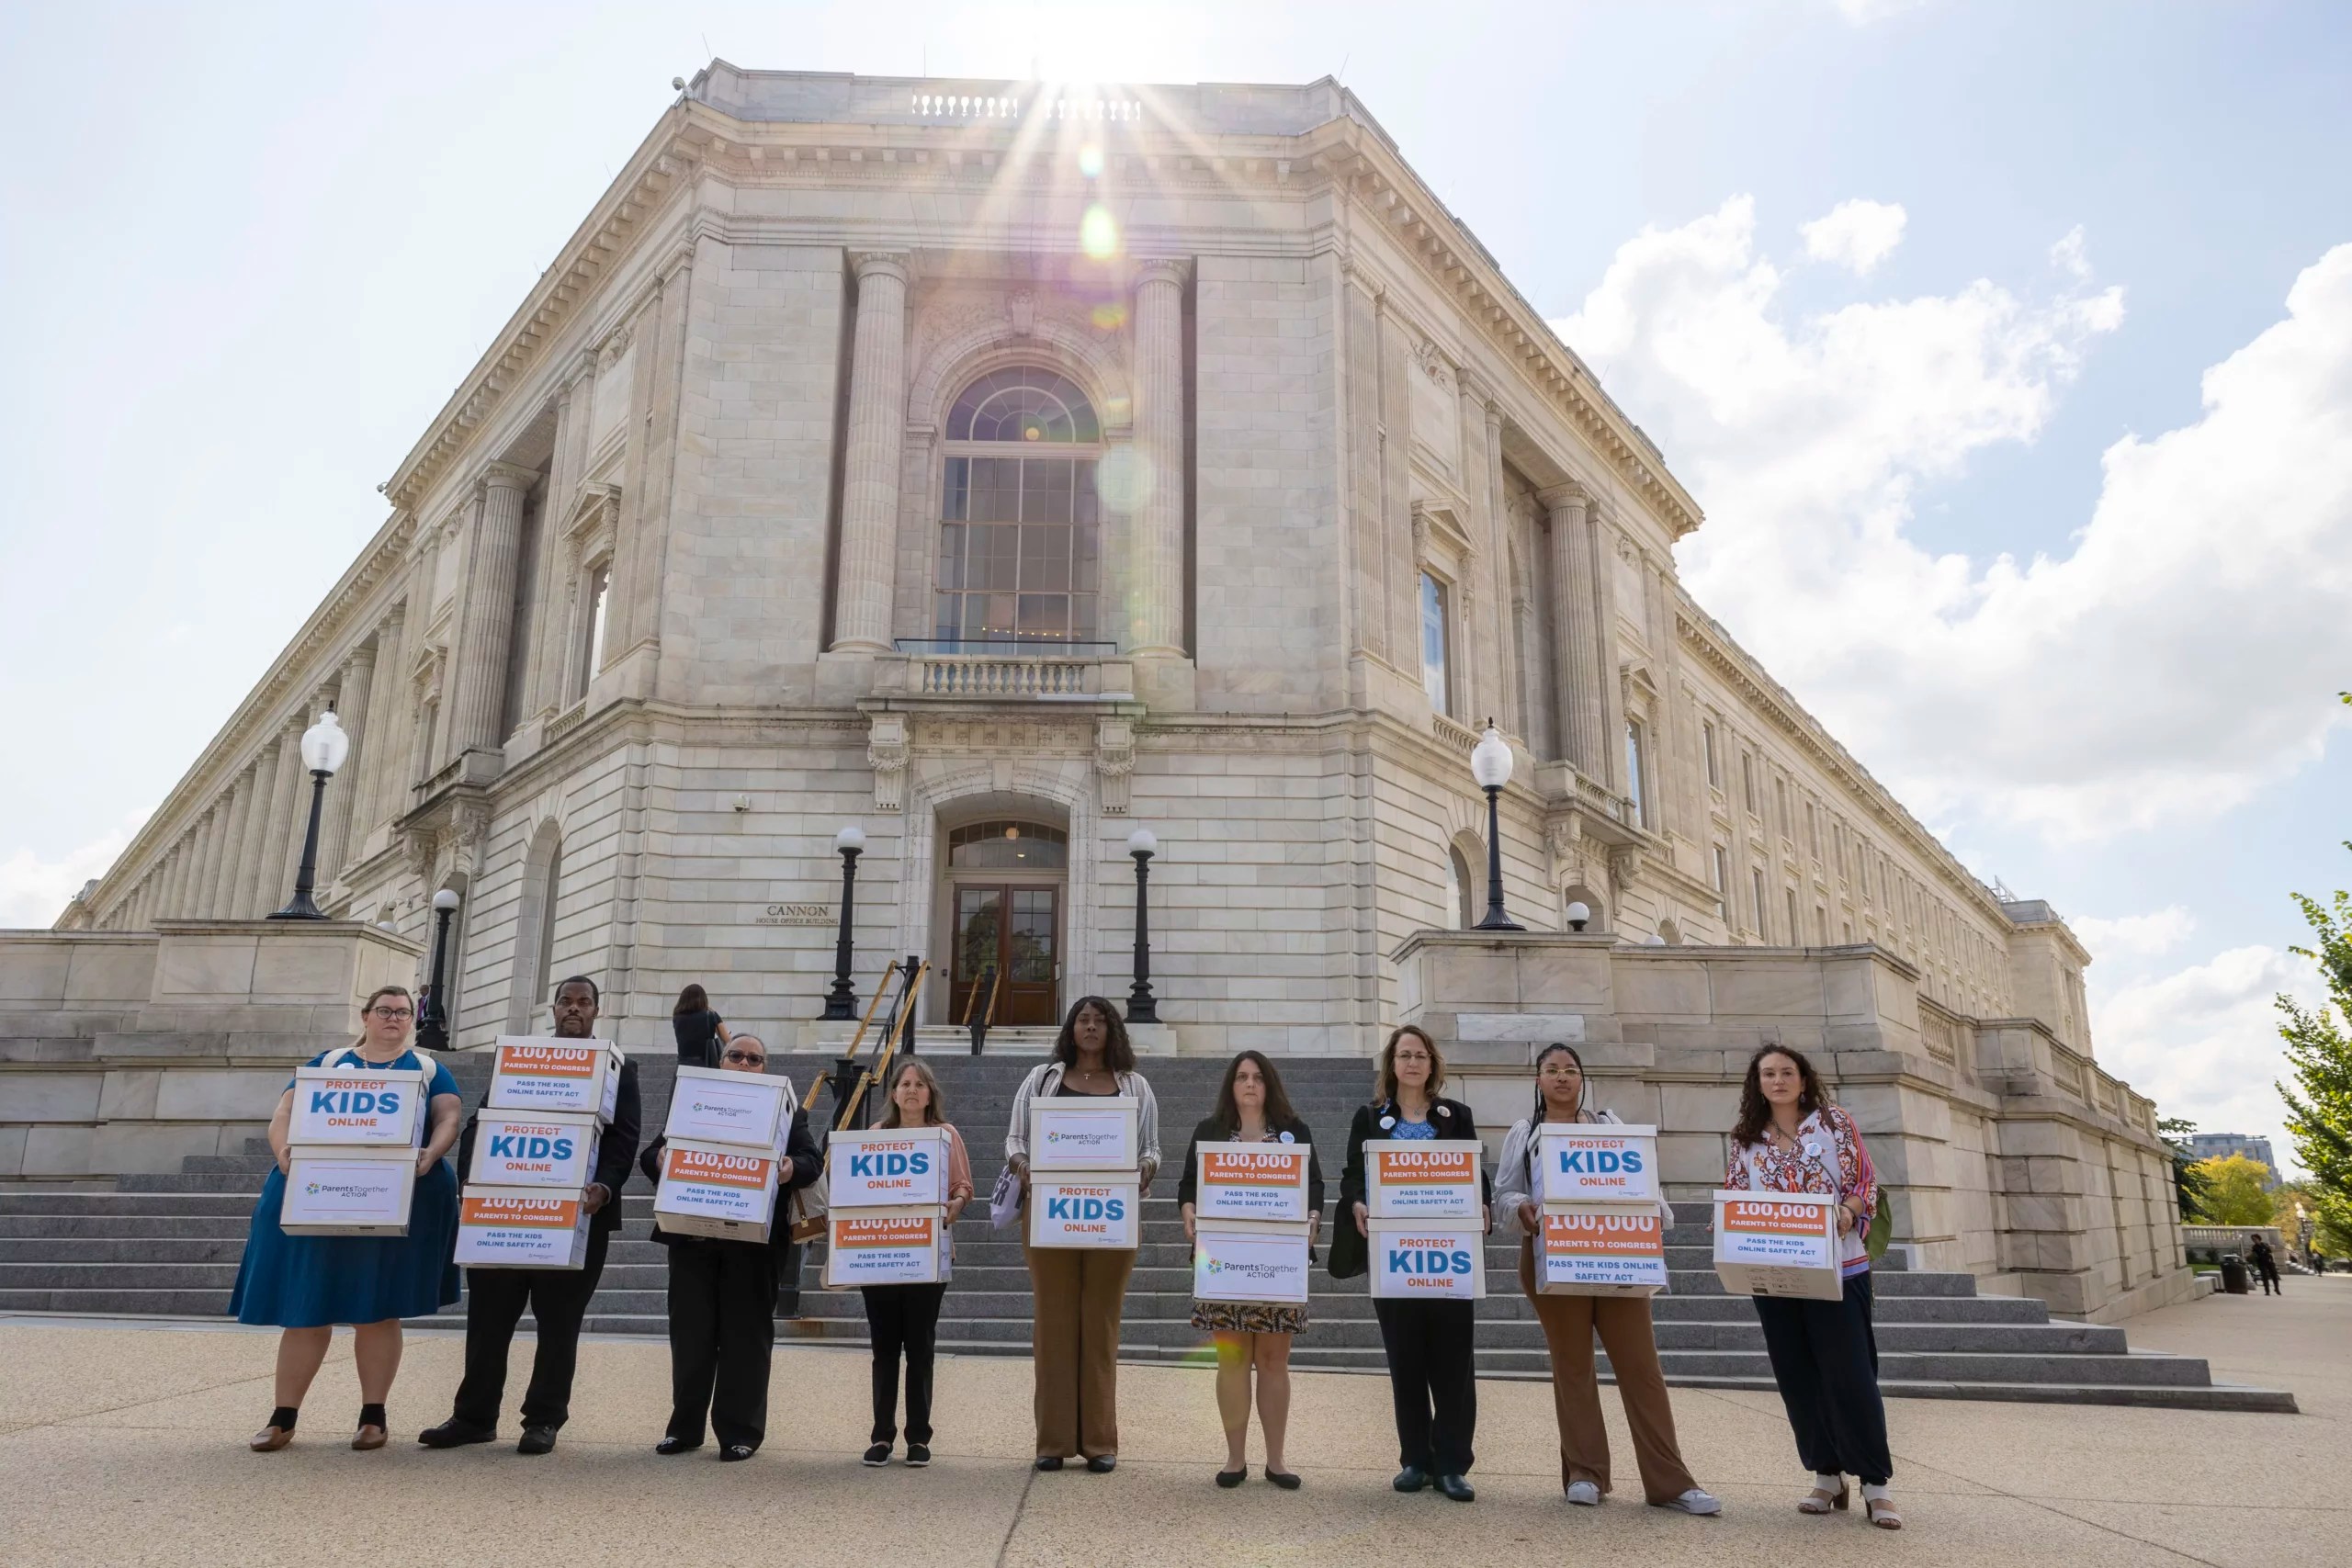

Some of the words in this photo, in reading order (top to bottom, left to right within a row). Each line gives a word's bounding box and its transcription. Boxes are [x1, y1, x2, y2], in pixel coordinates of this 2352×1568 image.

[767, 906, 829, 916] CANNON
[512, 1047, 588, 1062] 100,000
[325, 1080, 387, 1089] PROTECT
[311, 1091, 400, 1114] KIDS
[705, 1105, 752, 1115] ParentsTogether
[327, 1118, 378, 1126] ONLINE
[504, 1125, 561, 1135] PROTECT
[490, 1135, 572, 1160] KIDS
[862, 1143, 915, 1152] PROTECT
[506, 1163, 551, 1171] ONLINE
[683, 1151, 759, 1170] 100,000
[851, 1153, 929, 1177] KIDS
[1216, 1154, 1292, 1170] 100,000
[1388, 1153, 1464, 1168] 100,000
[1560, 1151, 1643, 1173] KIDS
[675, 1168, 708, 1177] PARENTS
[722, 1174, 761, 1182] CONGRESS
[867, 1179, 911, 1189] ONLINE
[1580, 1178, 1626, 1186] ONLINE
[1059, 1188, 1111, 1196] PROTECT
[481, 1198, 561, 1212] 100,000
[1048, 1198, 1125, 1221] KIDS
[1736, 1202, 1817, 1219] 100,000
[849, 1218, 924, 1231] 100,000
[1064, 1224, 1106, 1233] ONLINE
[1549, 1215, 1654, 1235] 100,000
[1399, 1239, 1455, 1247] PROTECT
[1225, 1263, 1297, 1273] ParentsTogether
[1389, 1250, 1472, 1274] KIDS
[1408, 1279, 1453, 1287] ONLINE
